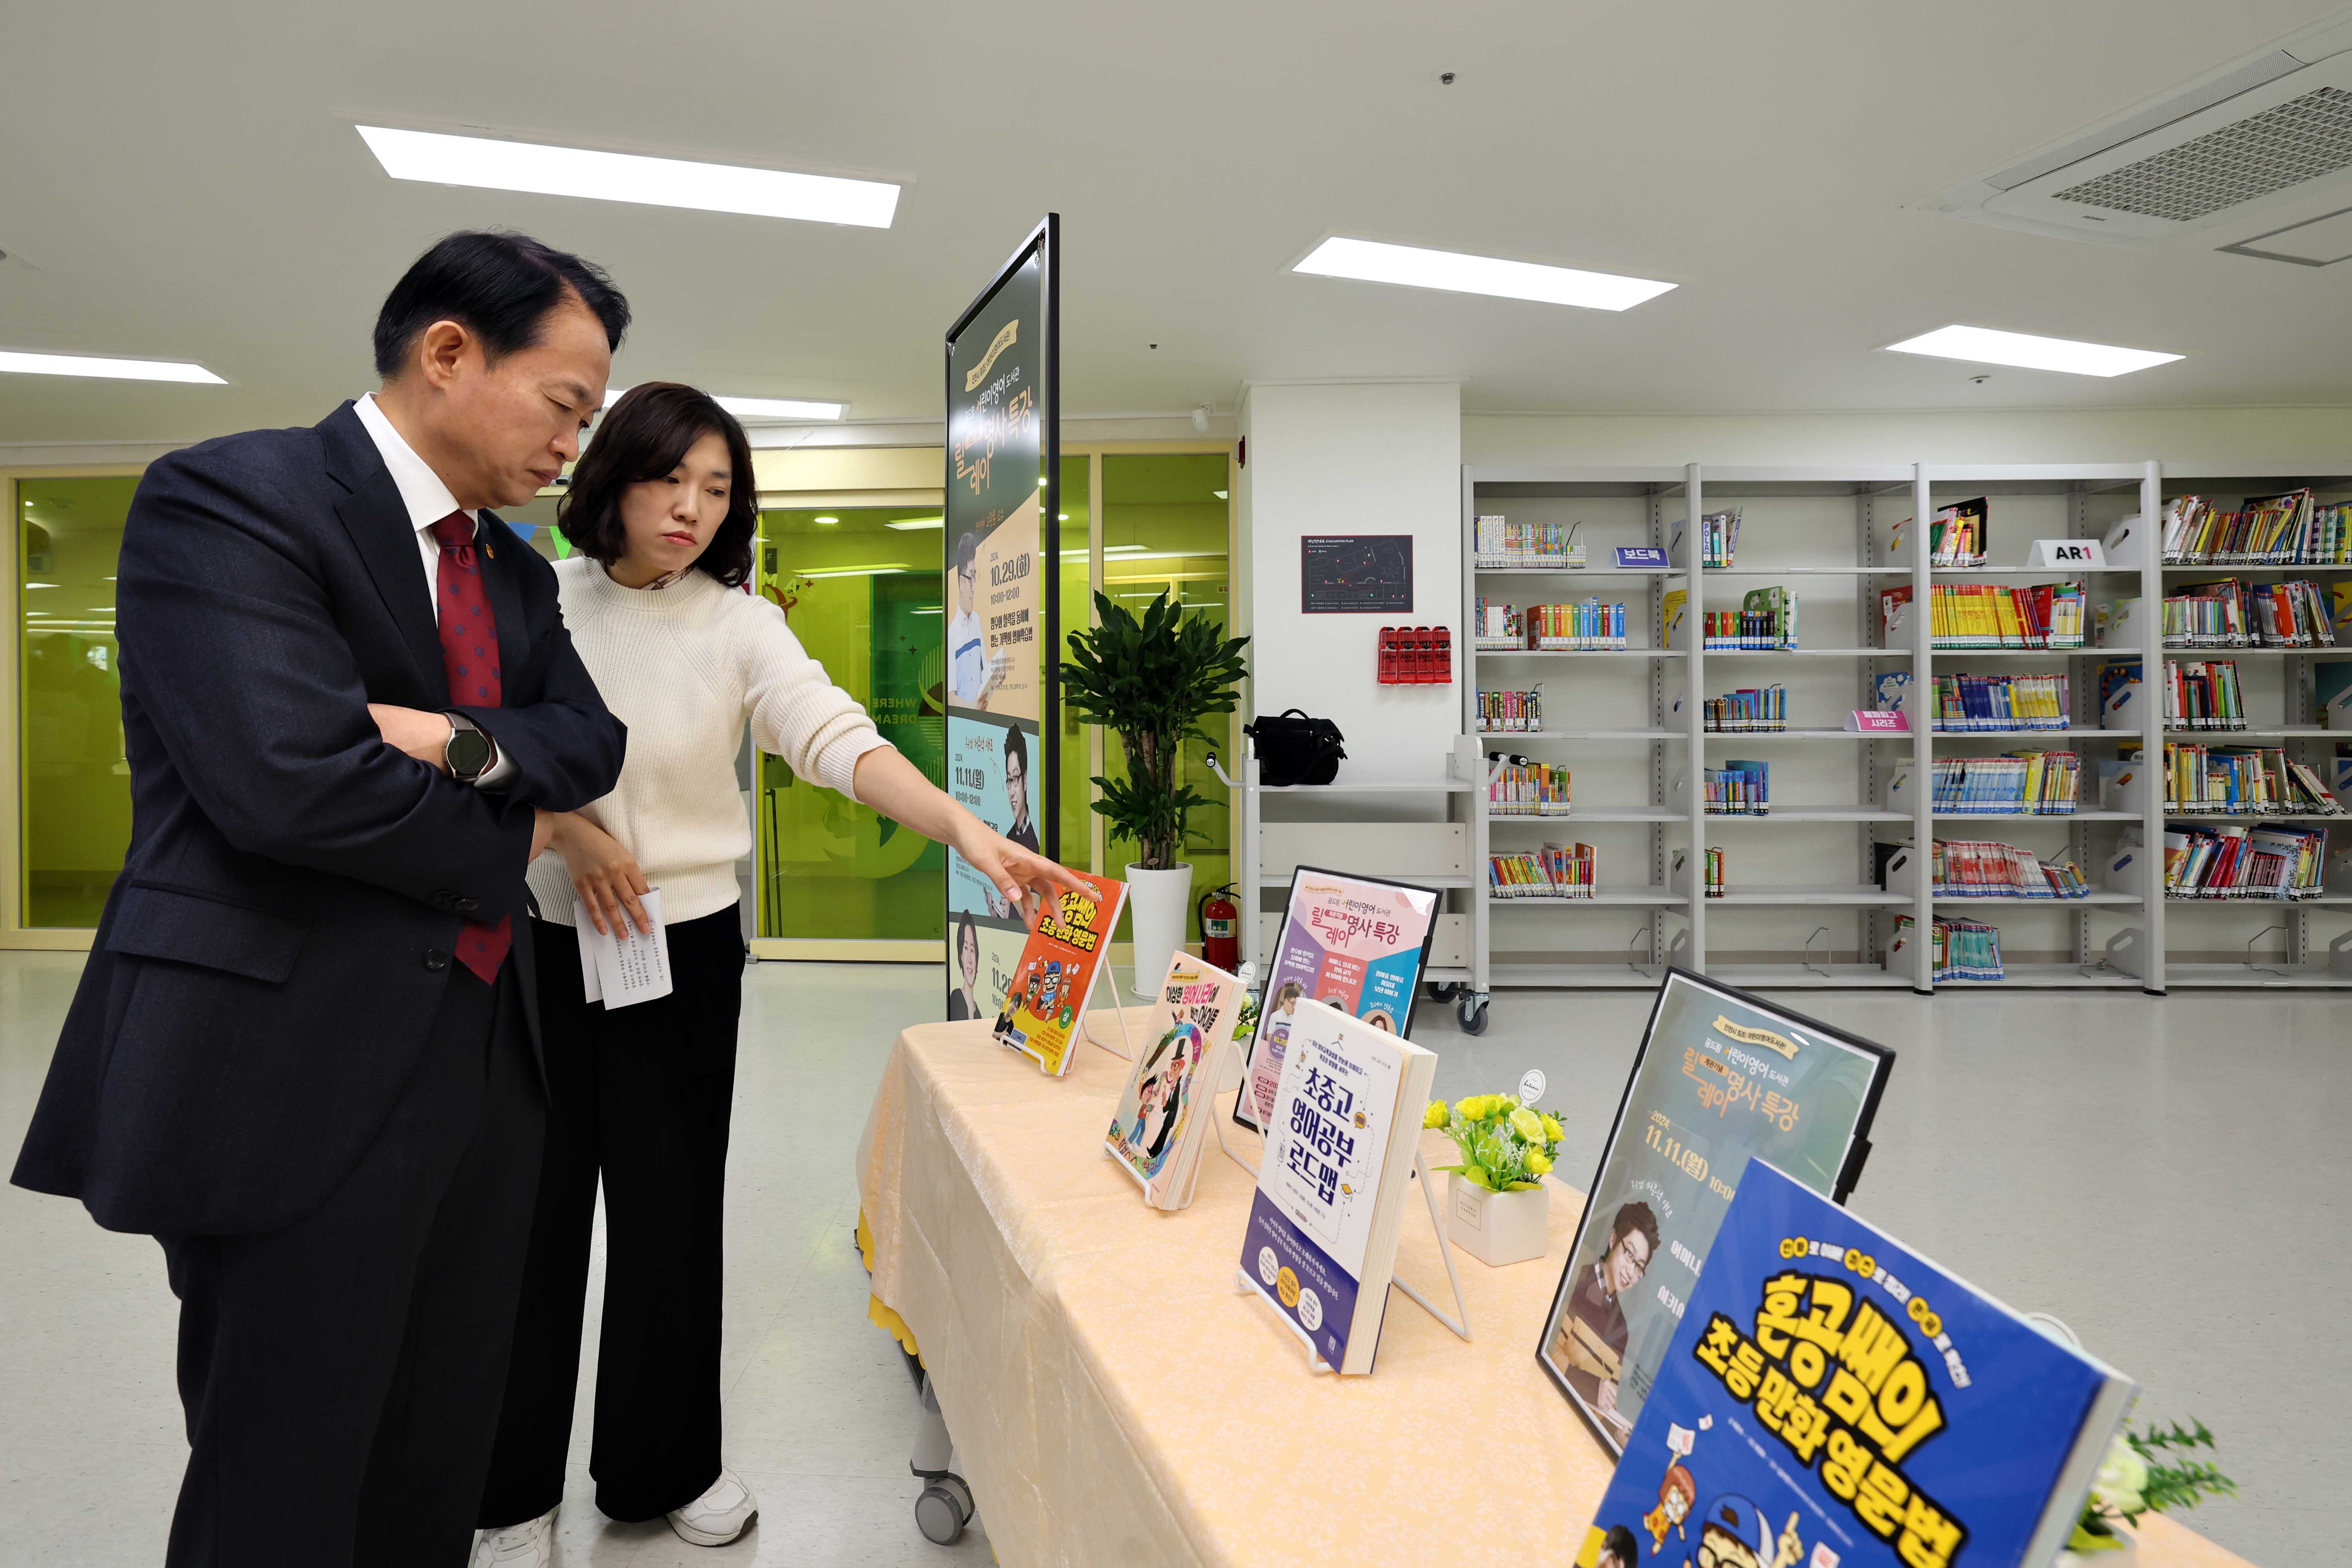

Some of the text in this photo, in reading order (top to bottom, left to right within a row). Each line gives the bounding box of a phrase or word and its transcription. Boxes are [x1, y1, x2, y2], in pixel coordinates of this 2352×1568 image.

[976, 374, 1005, 414] 어린이영어
[1006, 366, 1020, 388] 도서관
[1008, 386, 1033, 439] 특강
[1624, 549, 1660, 560] 보드북
[2056, 546, 2092, 560] AR1
[990, 553, 1030, 587] 10.29.(화)
[1004, 611, 1016, 627] 실력을
[1017, 608, 1029, 624] 동시에
[1013, 626, 1033, 644] 영어학습법
[986, 739, 993, 752] 대표
[955, 767, 984, 790] 11.11.(월)
[1327, 898, 1391, 917] 꿈드림 어린이영어 도서관
[1039, 916, 1057, 936] 초등
[1071, 929, 1098, 951] 영문법
[1311, 906, 1400, 948] 릴레이 명사 특강
[1342, 968, 1352, 977] 교육
[1390, 974, 1404, 984] 영어로
[1167, 982, 1220, 1004] 이상한 영어 나라에
[1374, 986, 1384, 995] 보낸
[1198, 1005, 1220, 1033] 아이들
[1724, 1023, 1737, 1034] 인천시
[1747, 1032, 1787, 1051] 어린이영어도서관!
[1338, 1065, 1349, 1076] 세우는
[1704, 1037, 1789, 1087] 꿈드림 어린이영어 도서관
[1704, 1058, 1723, 1073] 개관기념
[1303, 1066, 1354, 1123] 초중고
[1523, 1080, 1539, 1091] botanic
[1682, 1047, 1799, 1132] 릴레이 명사 특강
[1651, 1110, 1671, 1131] 2024.
[1290, 1098, 1355, 1168] 영어공부
[1645, 1125, 1709, 1182] 11.11.(월)
[1286, 1140, 1339, 1207] 로드맵
[1662, 1200, 1673, 1219] 대표
[1670, 1240, 1701, 1277] 어머니,
[1696, 1318, 1766, 1399] 초등
[1756, 1368, 1829, 1459] 만화
[1822, 1426, 1963, 1568] 영문법
